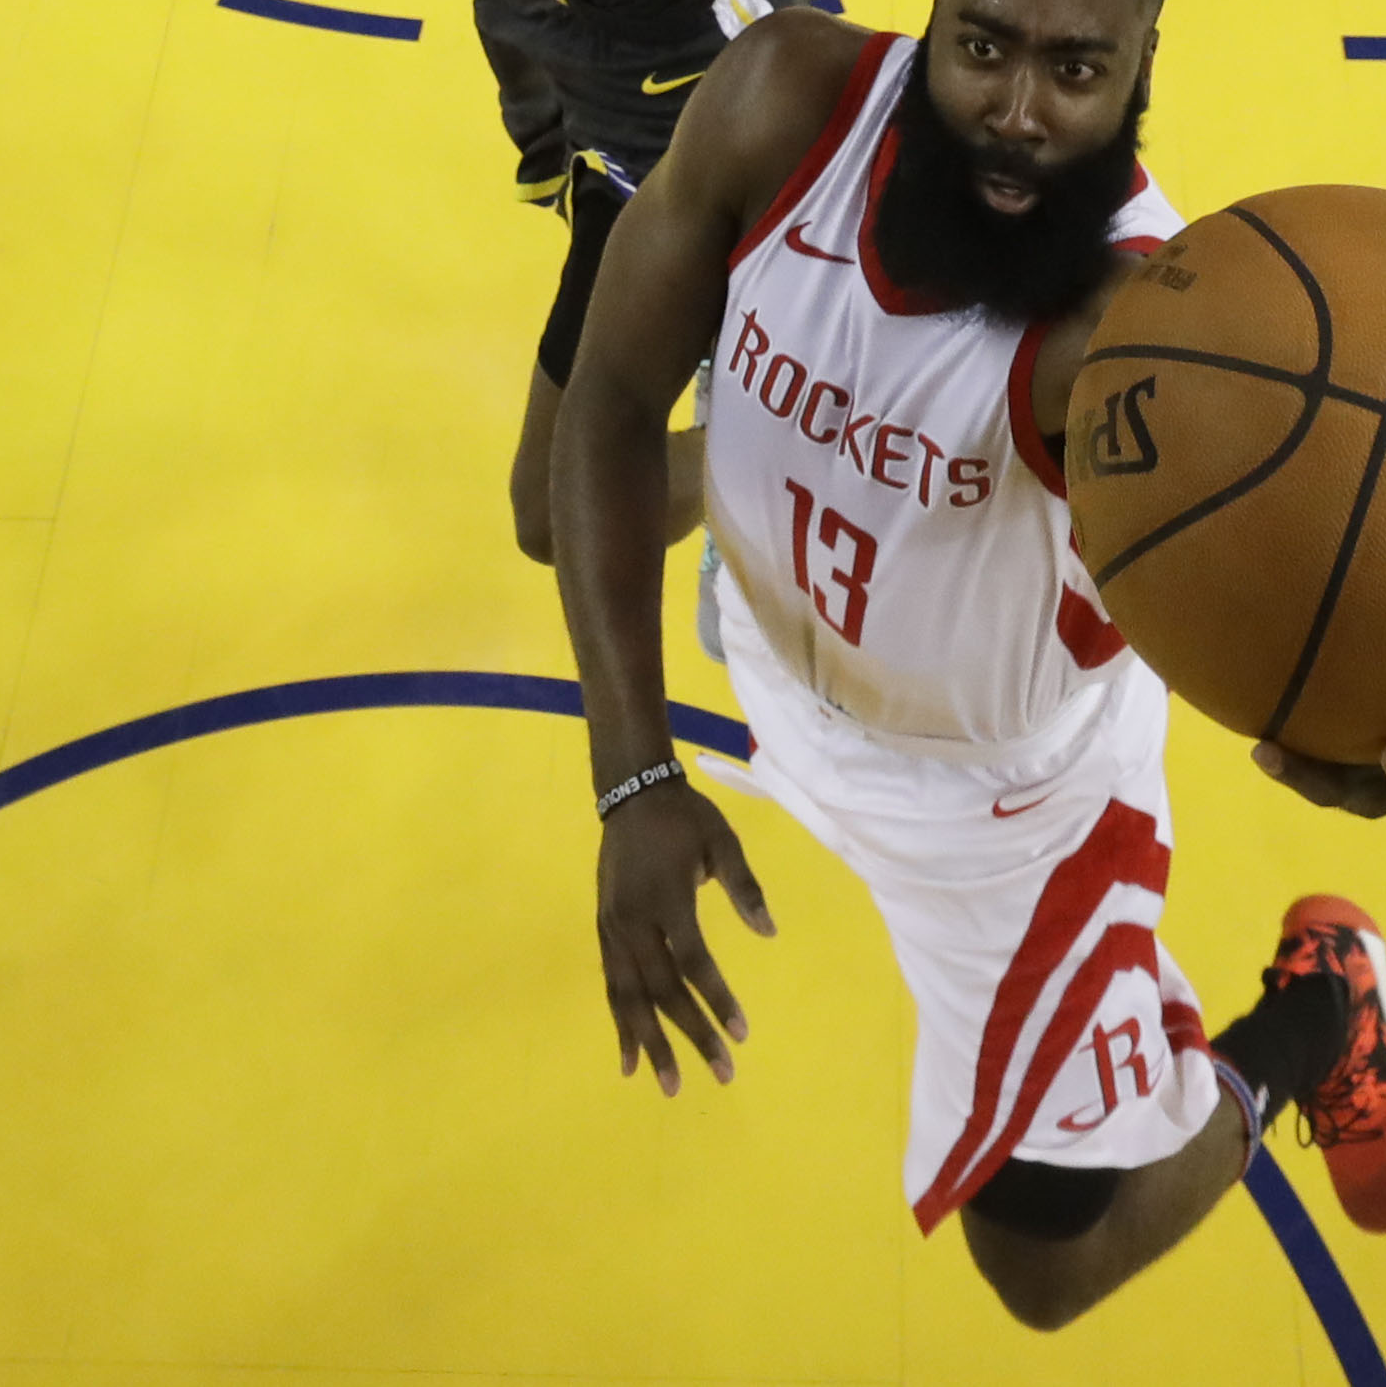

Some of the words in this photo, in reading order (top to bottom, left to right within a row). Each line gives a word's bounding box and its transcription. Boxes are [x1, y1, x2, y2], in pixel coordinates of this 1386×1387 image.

[728, 308, 992, 509] ROCKETS
[784, 476, 879, 648] 13
[641, 762, 670, 786] BIG
